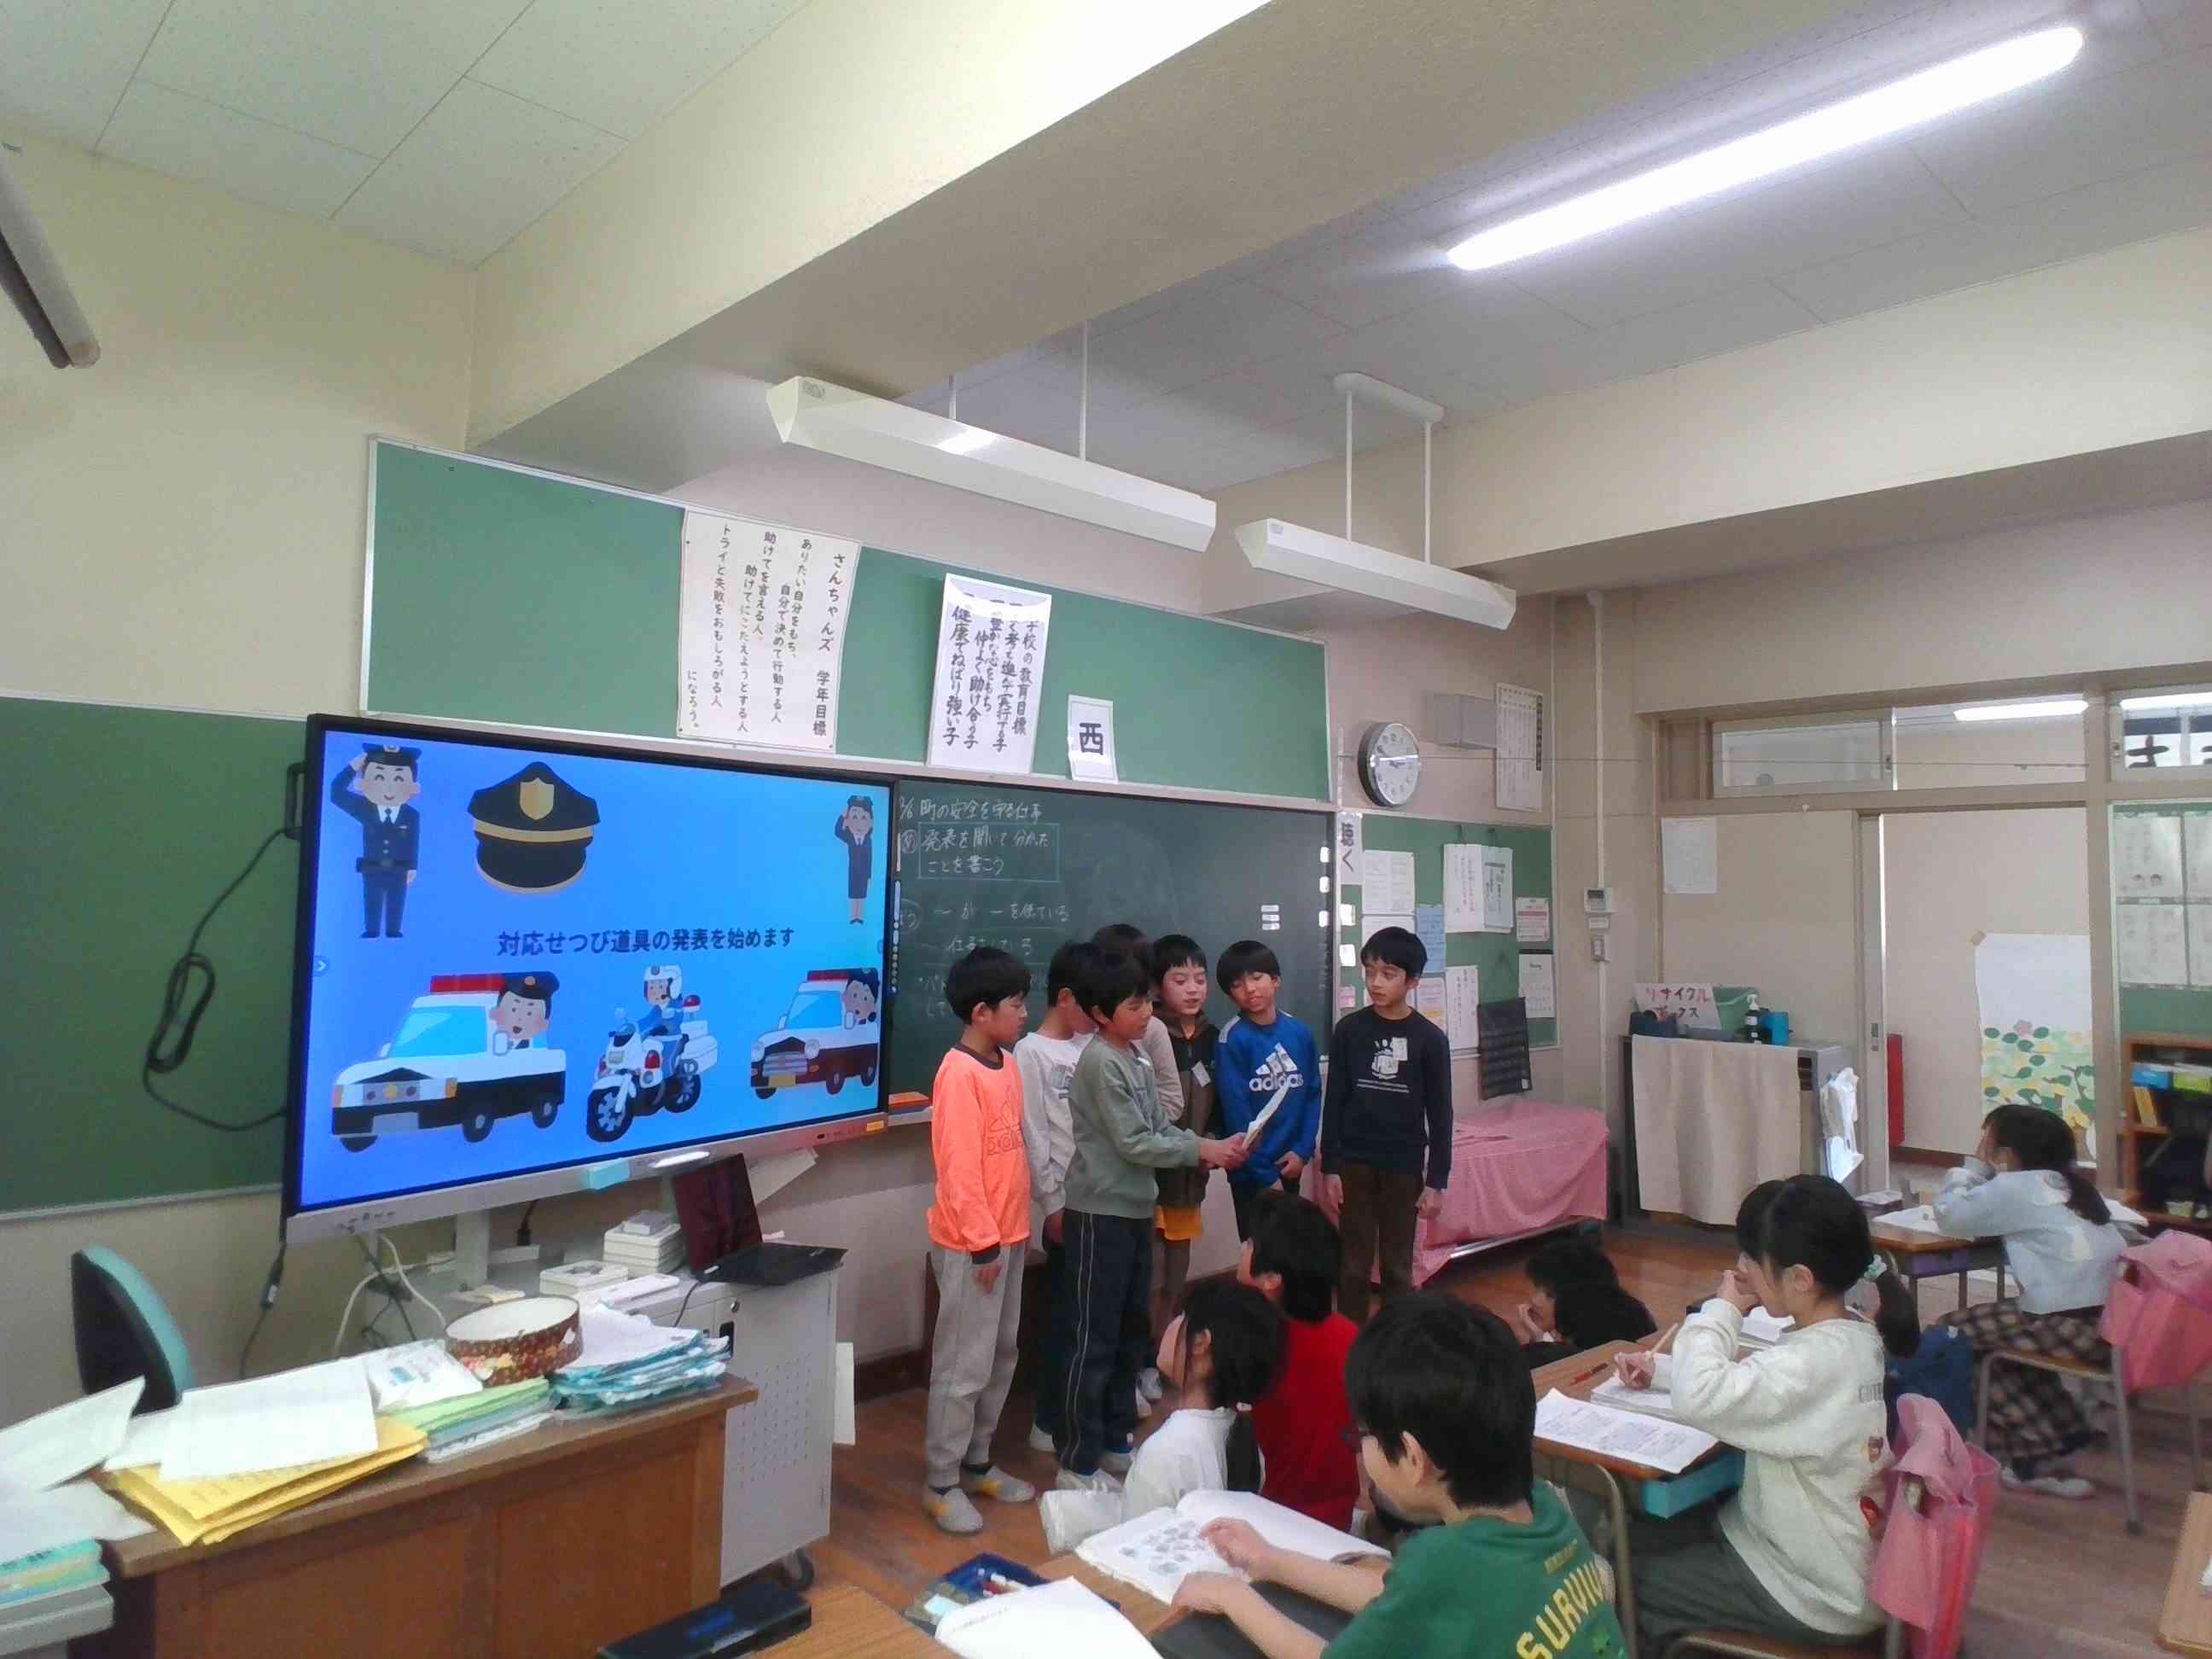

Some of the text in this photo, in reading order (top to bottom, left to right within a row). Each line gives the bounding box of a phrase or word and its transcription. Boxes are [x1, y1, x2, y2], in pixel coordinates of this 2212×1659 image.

[711, 524, 731, 708] トライと失敗をおもしろがる人
[771, 583, 791, 724] 自分で決めて行動する人
[812, 554, 847, 736] さんちゃんズ 学年目標
[1079, 722, 1105, 755] 西
[497, 927, 795, 957] 対応せつび道具の発表を始めます
[1645, 987, 1710, 1003] リサイクル
